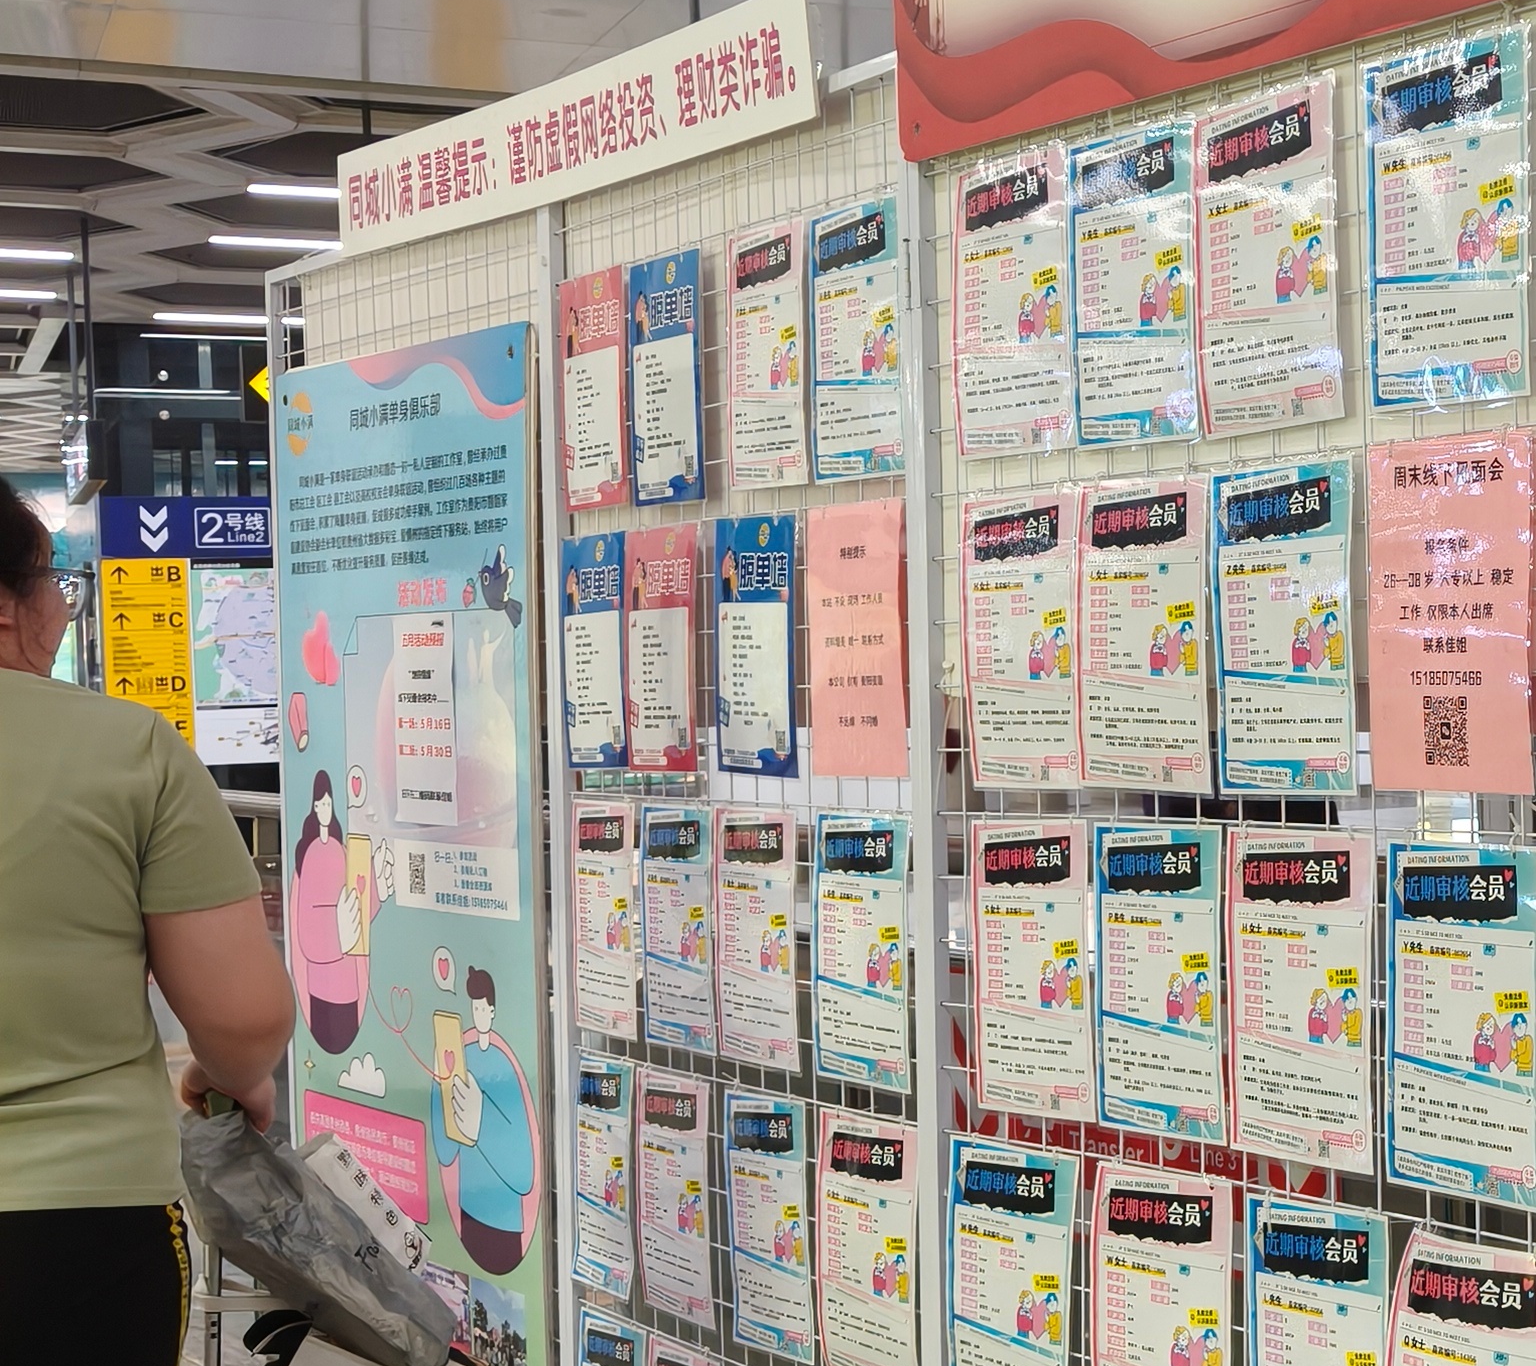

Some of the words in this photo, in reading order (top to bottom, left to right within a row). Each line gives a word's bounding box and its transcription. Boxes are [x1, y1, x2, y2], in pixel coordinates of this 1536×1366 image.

[167, 566, 181, 582] B
[169, 612, 184, 628] C
[1423, 637, 1468, 653] 联系佳姐
[171, 676, 186, 692] D
[1410, 671, 1482, 686] 15185075466
